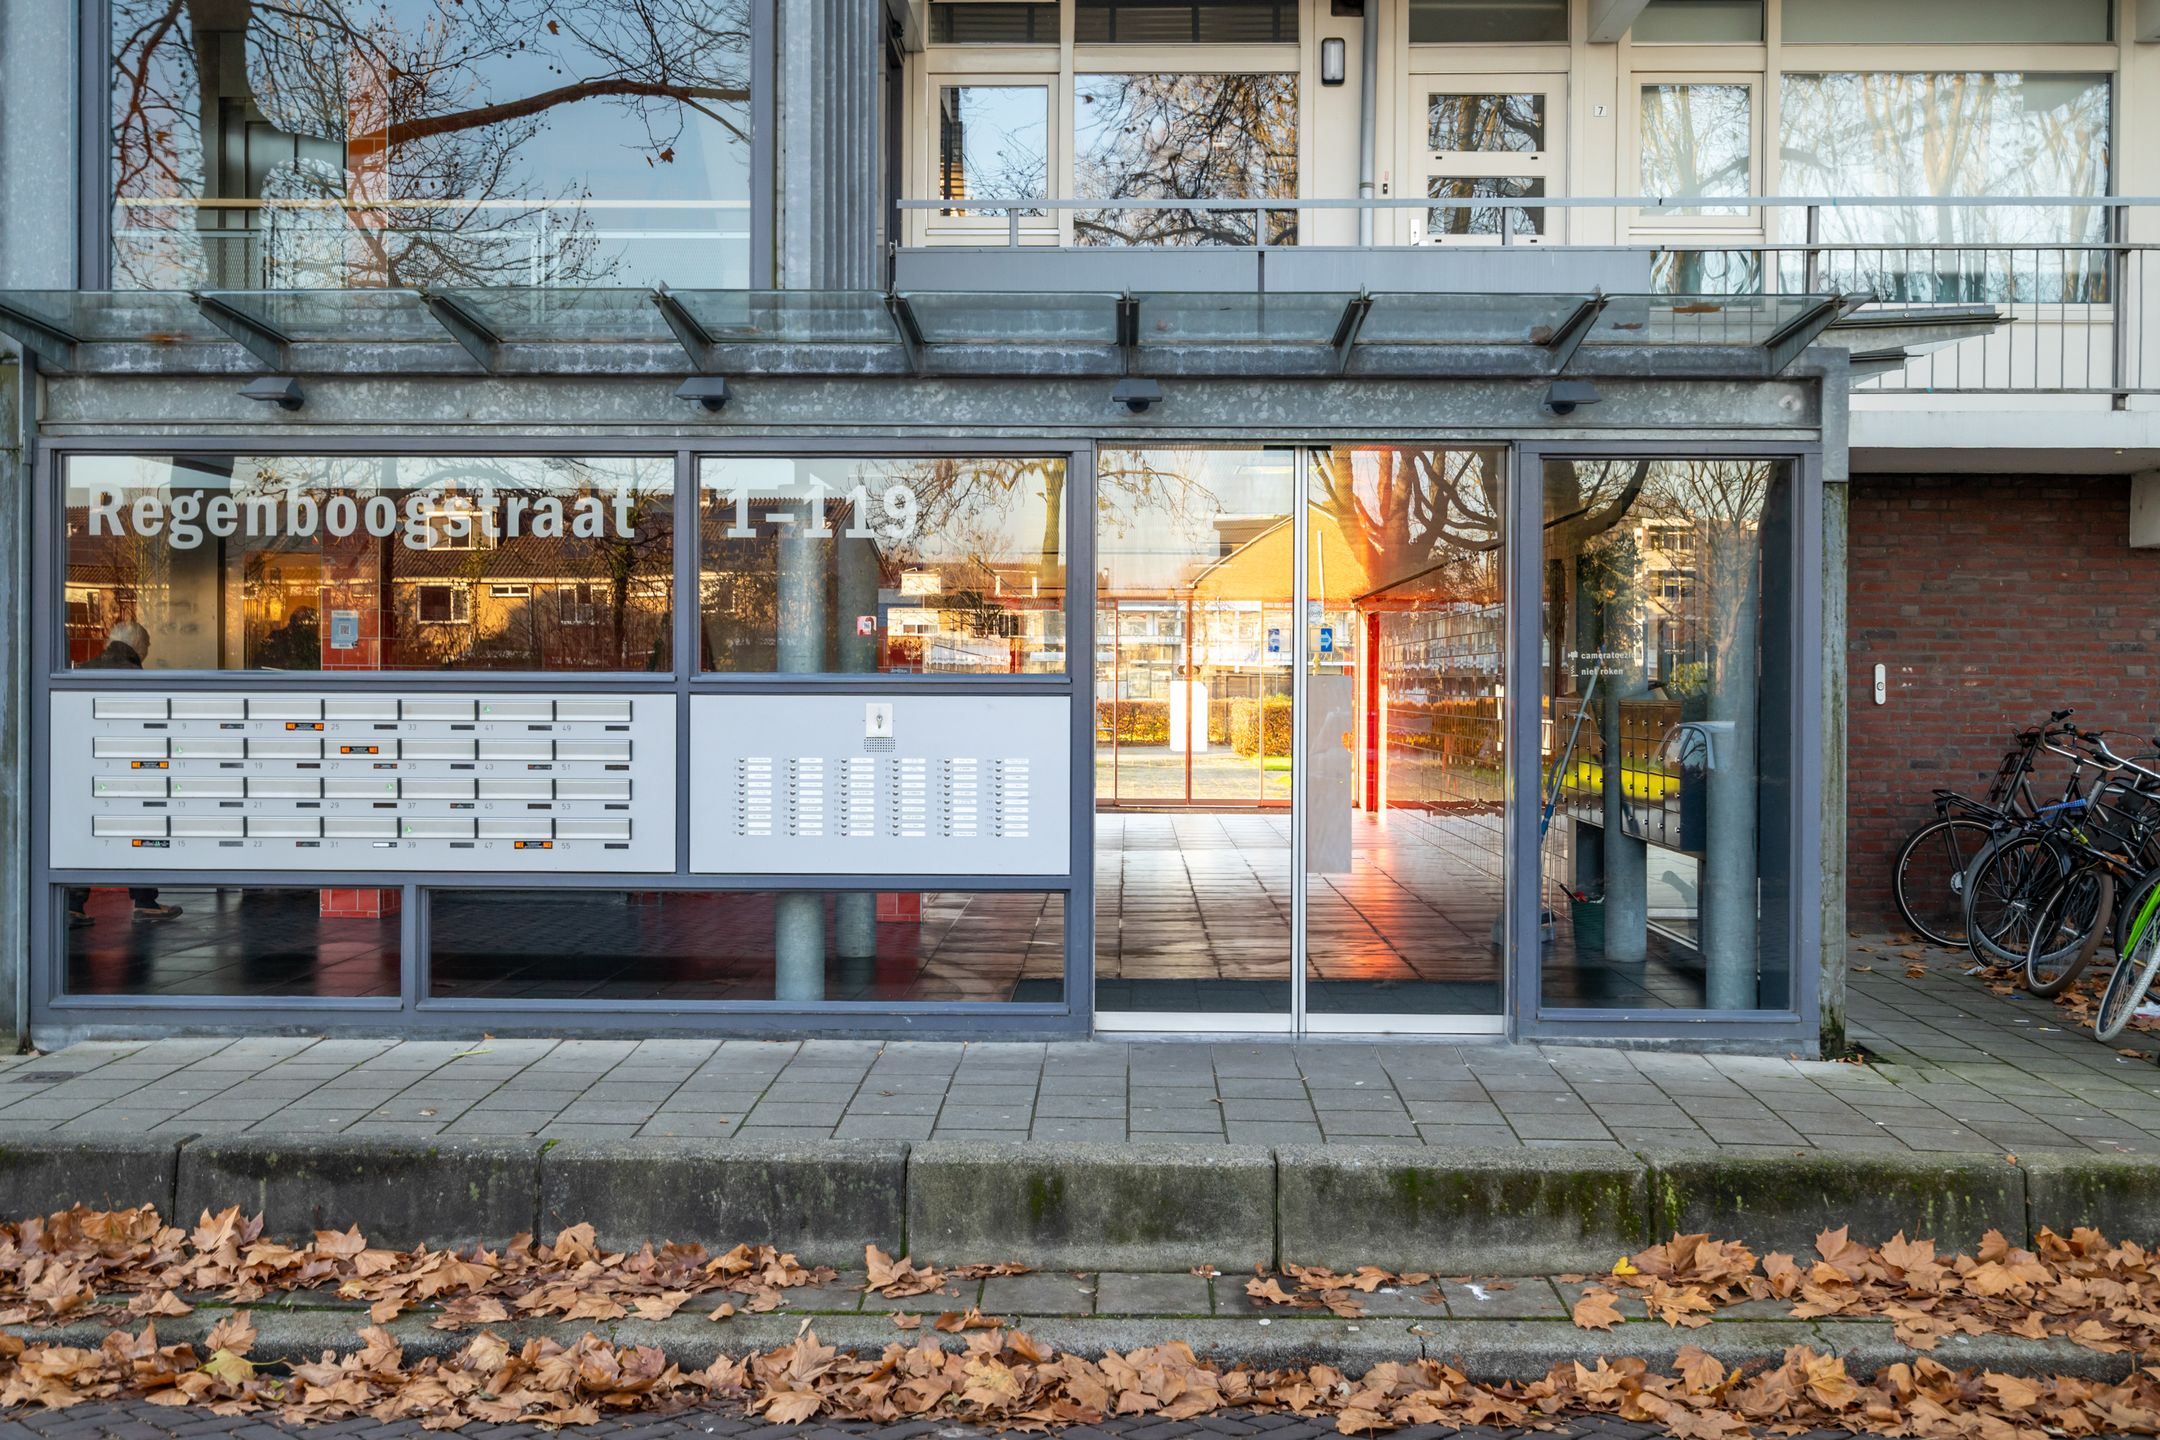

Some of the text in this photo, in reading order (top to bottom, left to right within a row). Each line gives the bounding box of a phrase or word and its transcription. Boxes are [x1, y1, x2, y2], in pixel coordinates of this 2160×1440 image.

[88, 482, 635, 550] Regenboogstraat
[1581, 652, 1644, 660] cameratoezic
[1600, 667, 1624, 675] roken
